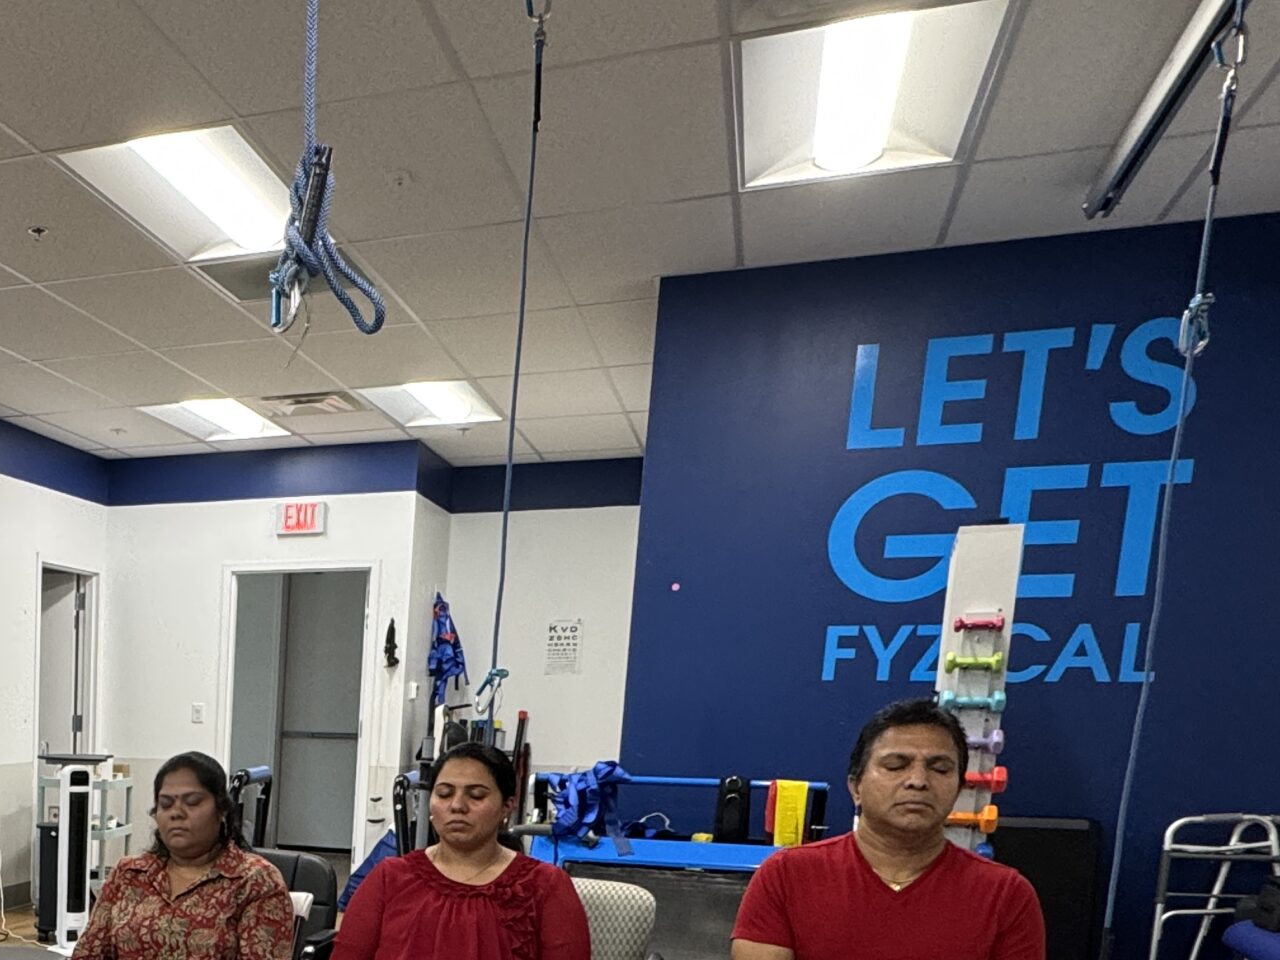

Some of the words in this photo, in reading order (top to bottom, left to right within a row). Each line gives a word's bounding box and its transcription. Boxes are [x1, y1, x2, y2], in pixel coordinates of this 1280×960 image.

[846, 317, 1197, 450] LET'S
[284, 502, 318, 530] EXIT
[828, 459, 1194, 603] GET
[820, 622, 1155, 684] FYZCAL
